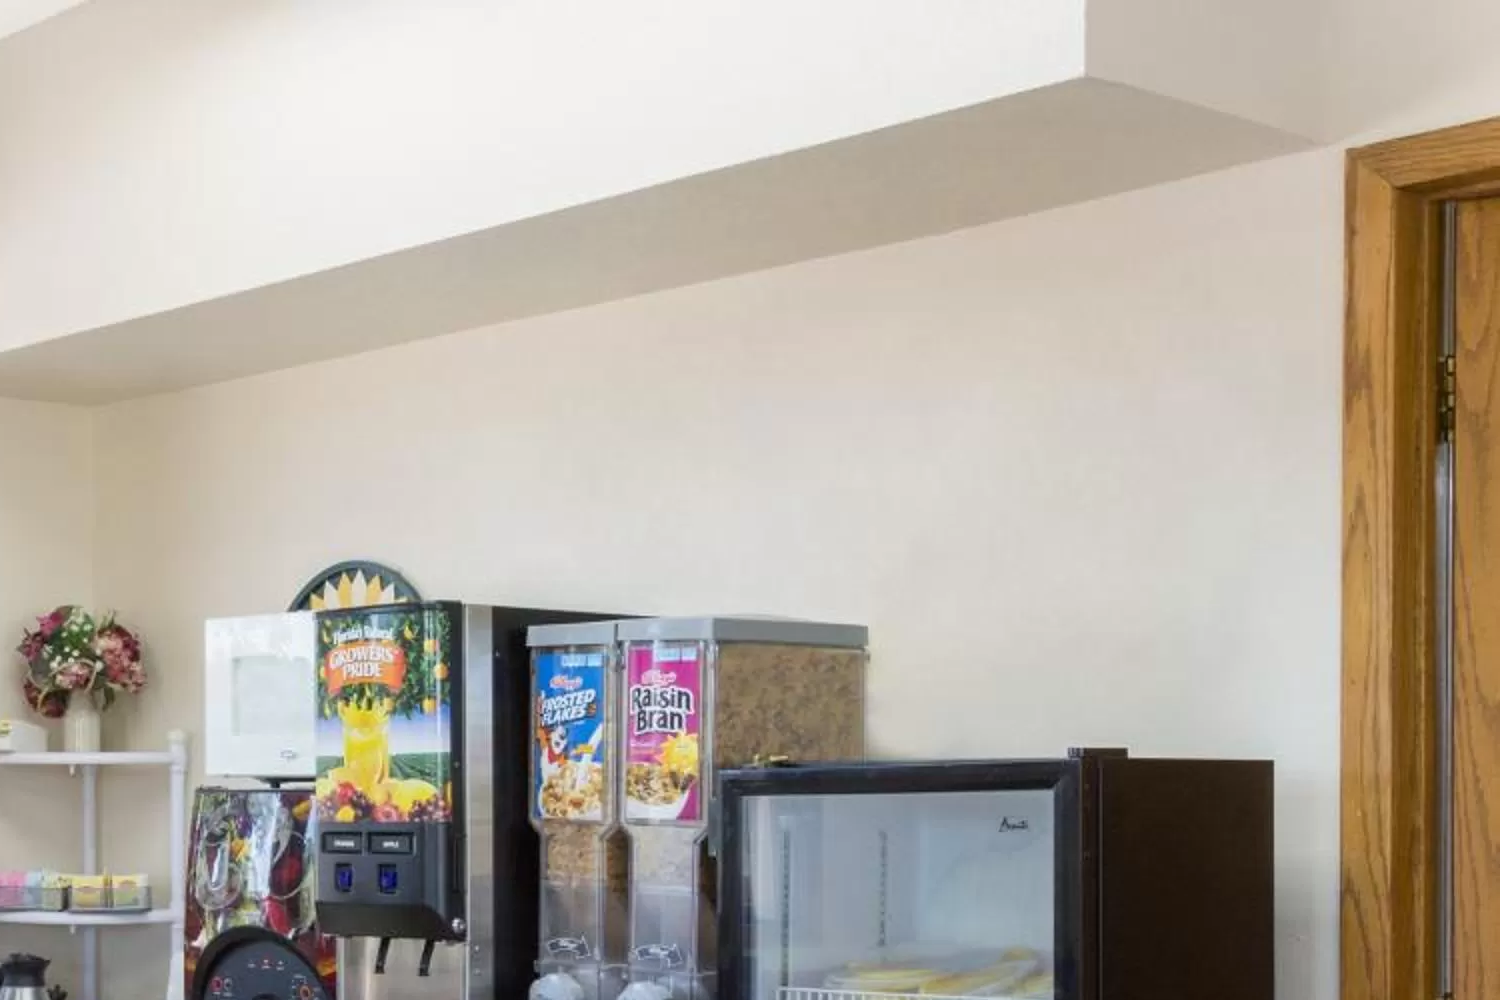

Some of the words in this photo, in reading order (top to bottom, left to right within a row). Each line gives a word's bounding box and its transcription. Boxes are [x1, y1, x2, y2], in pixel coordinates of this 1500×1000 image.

[343, 662, 383, 681] PRIDE
[543, 688, 596, 713] FROSTED
[631, 686, 693, 712] Raisin
[543, 704, 586, 726] FLAKES
[636, 708, 684, 732] Bran
